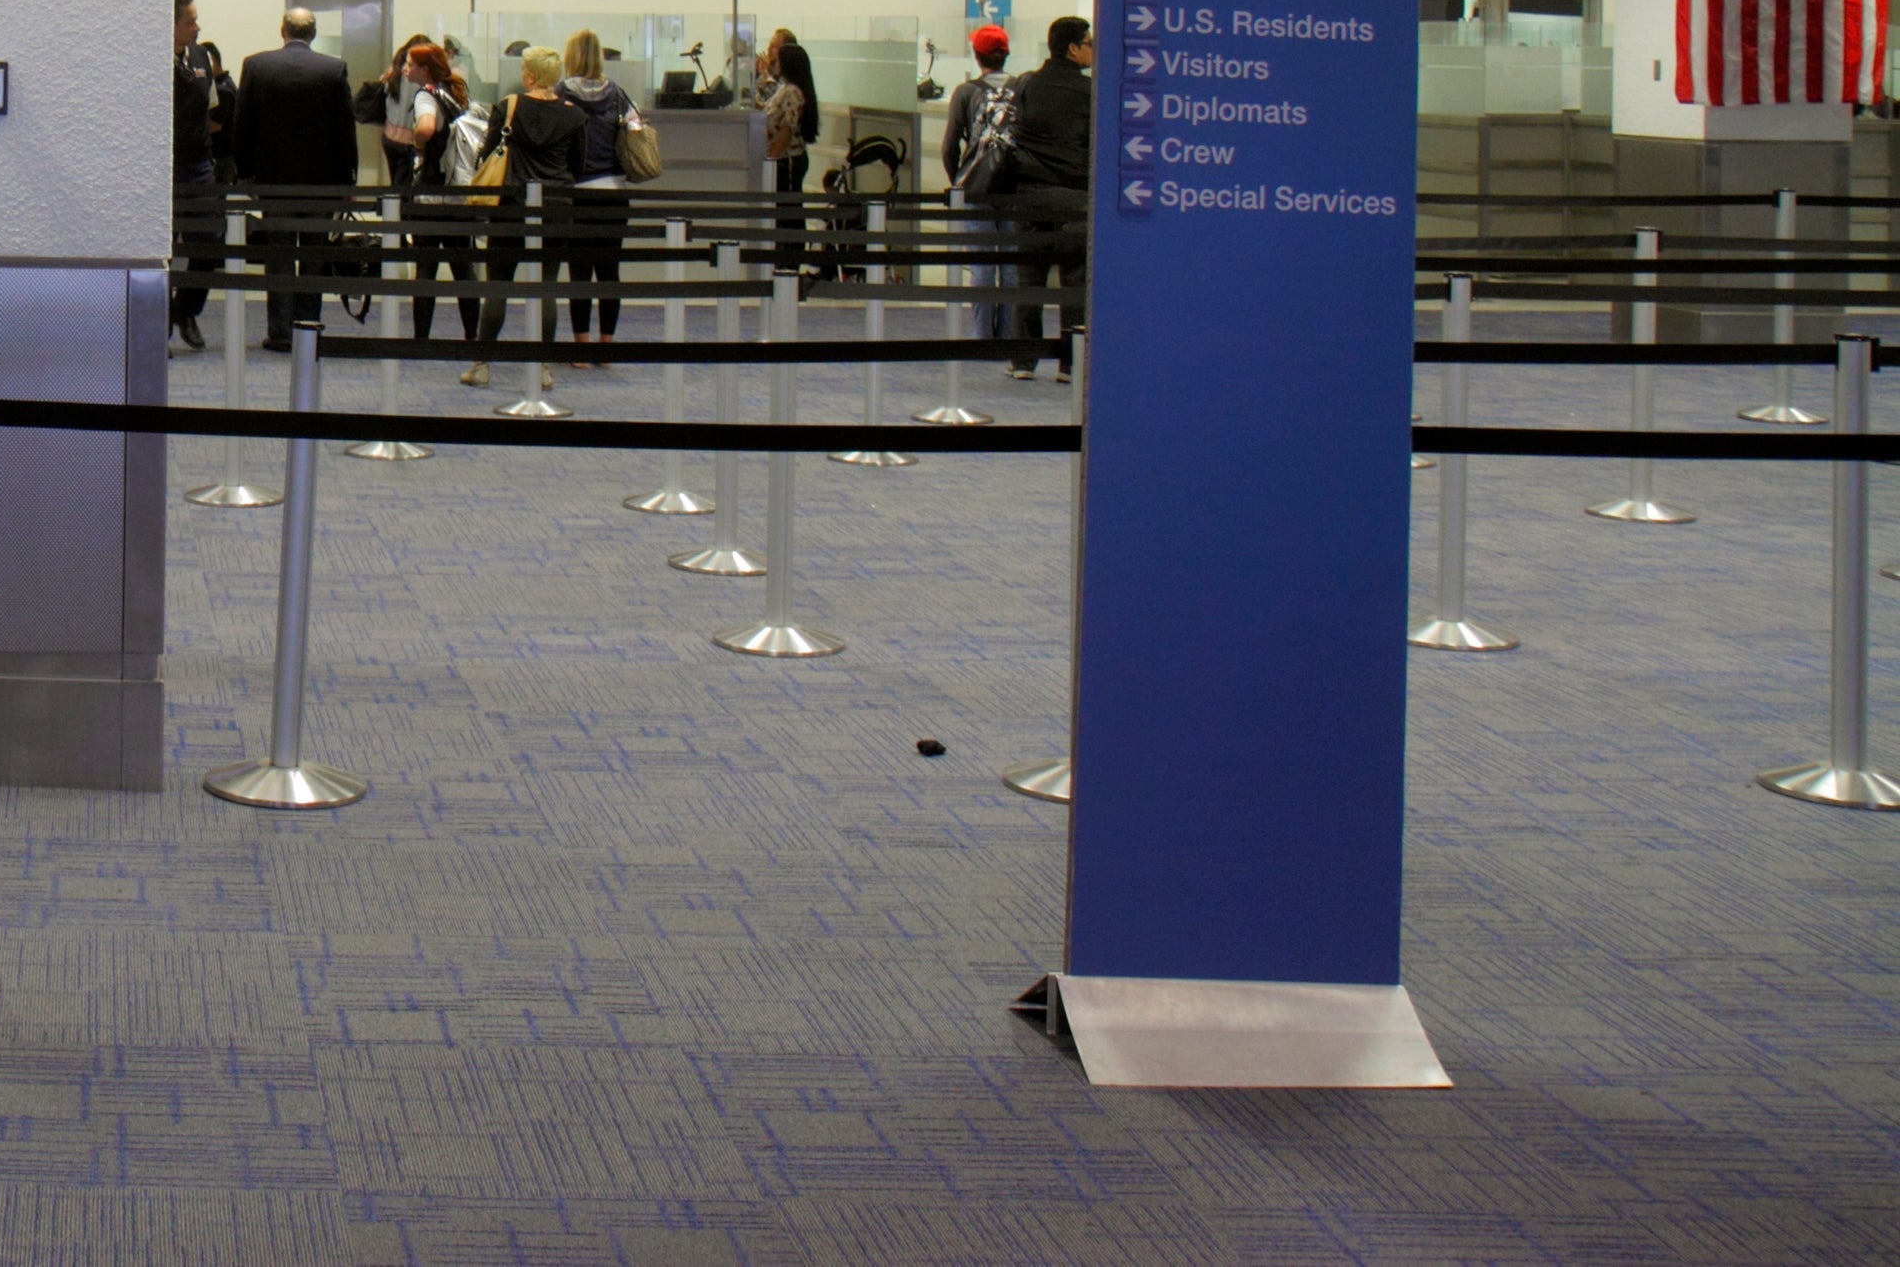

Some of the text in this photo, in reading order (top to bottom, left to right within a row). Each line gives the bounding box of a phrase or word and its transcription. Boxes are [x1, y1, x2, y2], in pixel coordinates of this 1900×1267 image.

[1163, 7, 1375, 42] U.S. Residents
[1162, 50, 1270, 80] Visitors
[1161, 94, 1308, 126] Diplomats
[1159, 137, 1236, 165] Crew
[1159, 180, 1397, 216] Special Services
